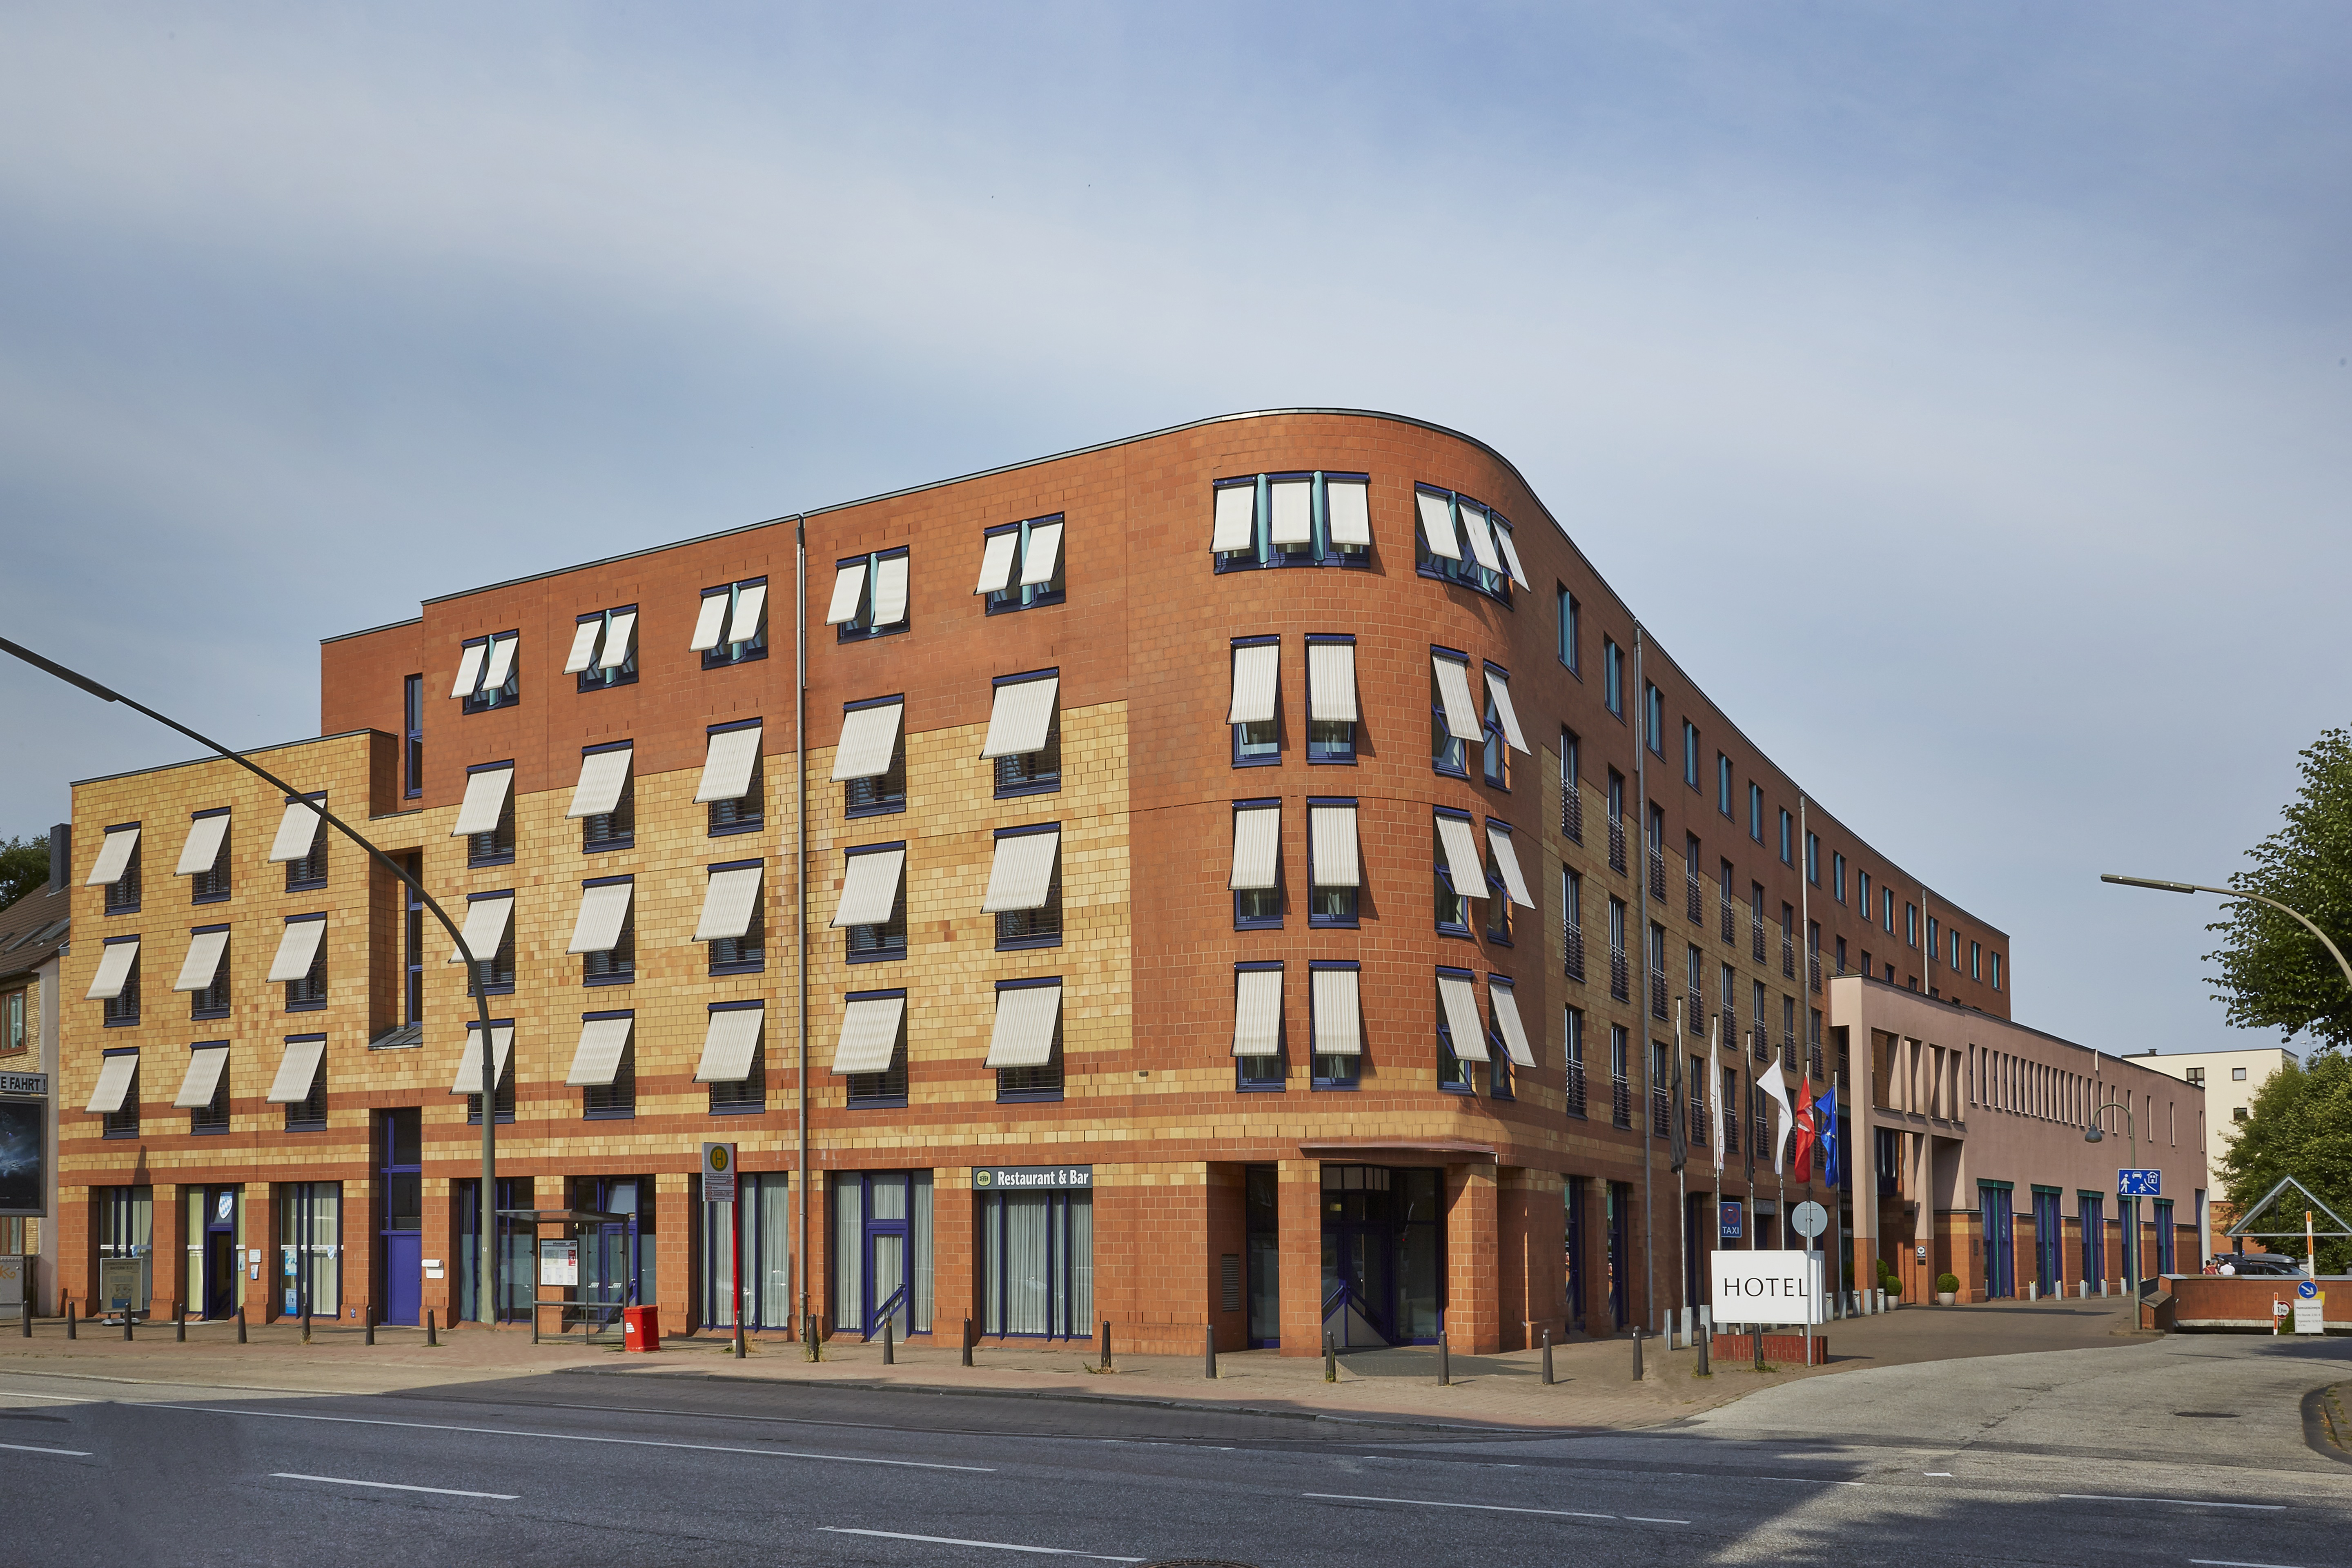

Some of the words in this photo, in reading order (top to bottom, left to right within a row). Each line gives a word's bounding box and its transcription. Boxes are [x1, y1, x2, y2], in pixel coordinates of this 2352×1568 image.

[0, 1076, 7, 1089] E
[10, 1077, 40, 1091] FAHRT
[43, 1079, 46, 1091] !
[715, 1152, 723, 1166] H
[998, 1171, 1055, 1185] Restaurant
[1058, 1170, 1067, 1184] &
[1070, 1169, 1089, 1184] Bar
[1724, 1278, 1808, 1297] HOTEL
